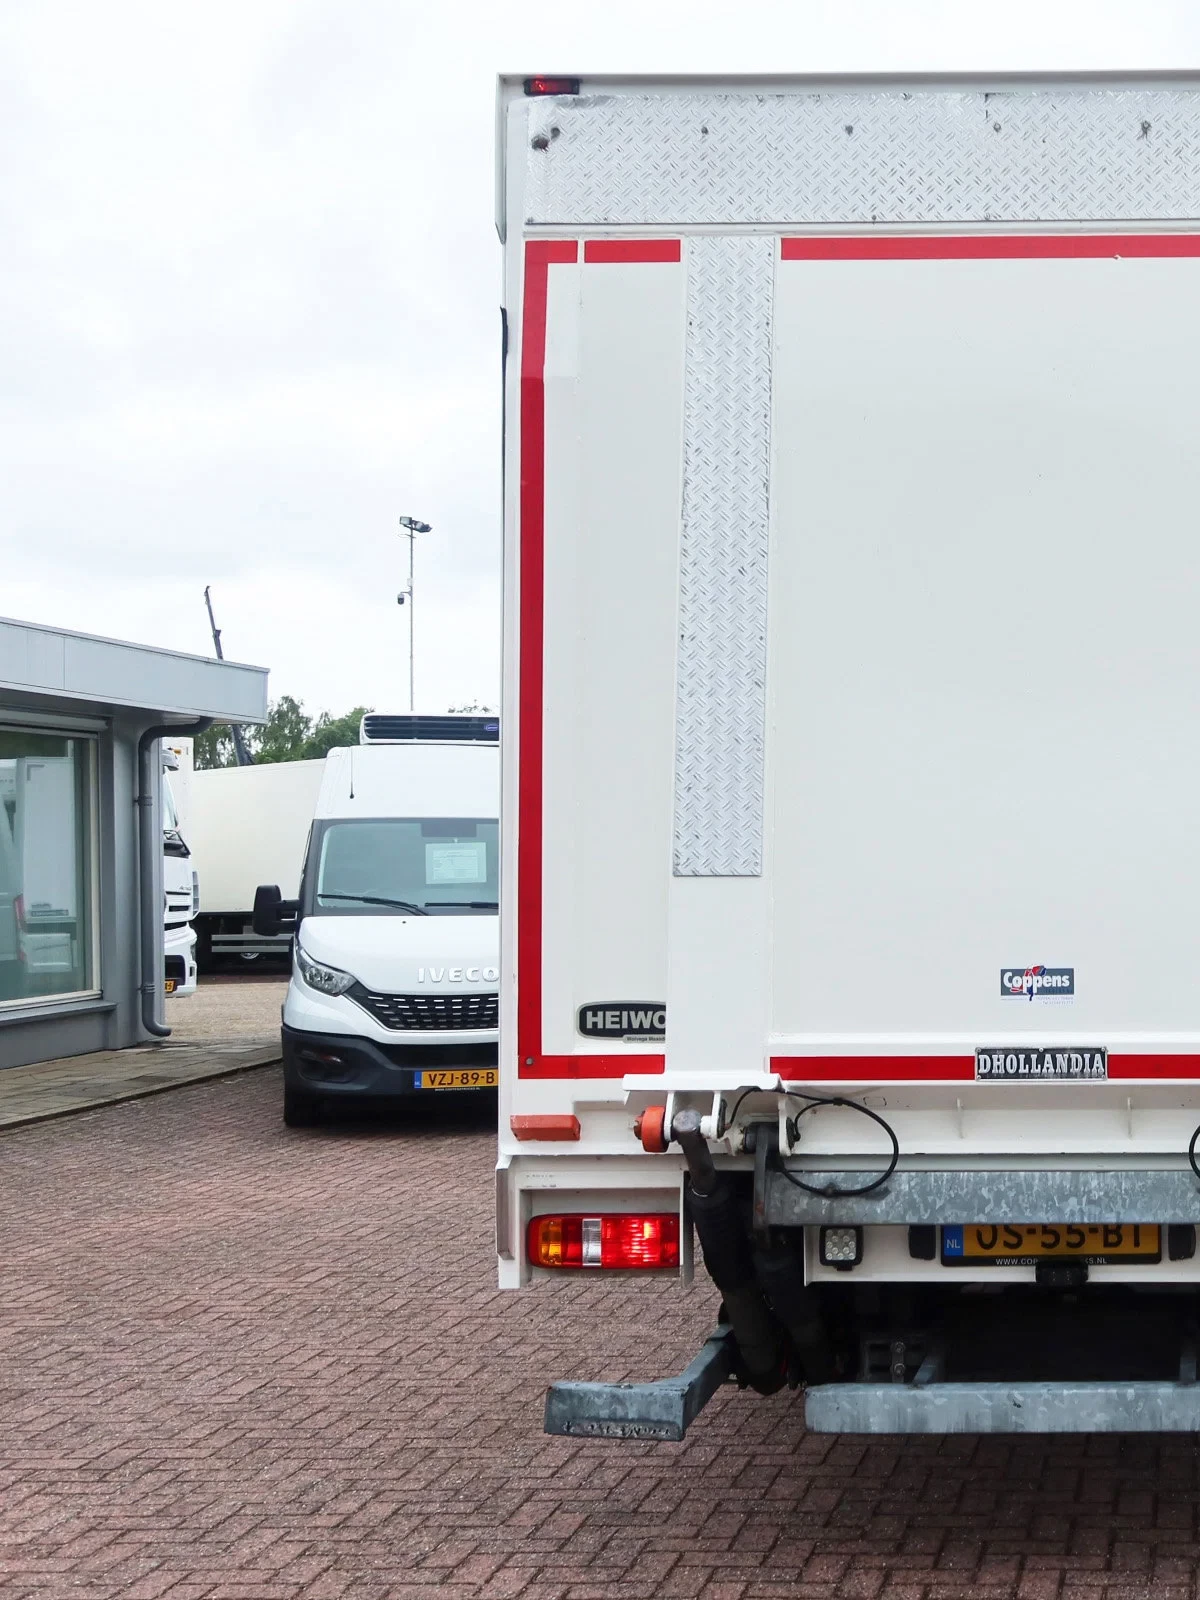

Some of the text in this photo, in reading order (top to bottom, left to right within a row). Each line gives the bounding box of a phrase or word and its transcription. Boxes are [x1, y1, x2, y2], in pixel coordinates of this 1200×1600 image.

[417, 967, 500, 983] IVECO
[1003, 971, 1070, 994] Coppens
[978, 1053, 1105, 1074] DHOLLANDIA
[428, 1072, 495, 1086] VZJ-89-B
[946, 1239, 961, 1249] NL
